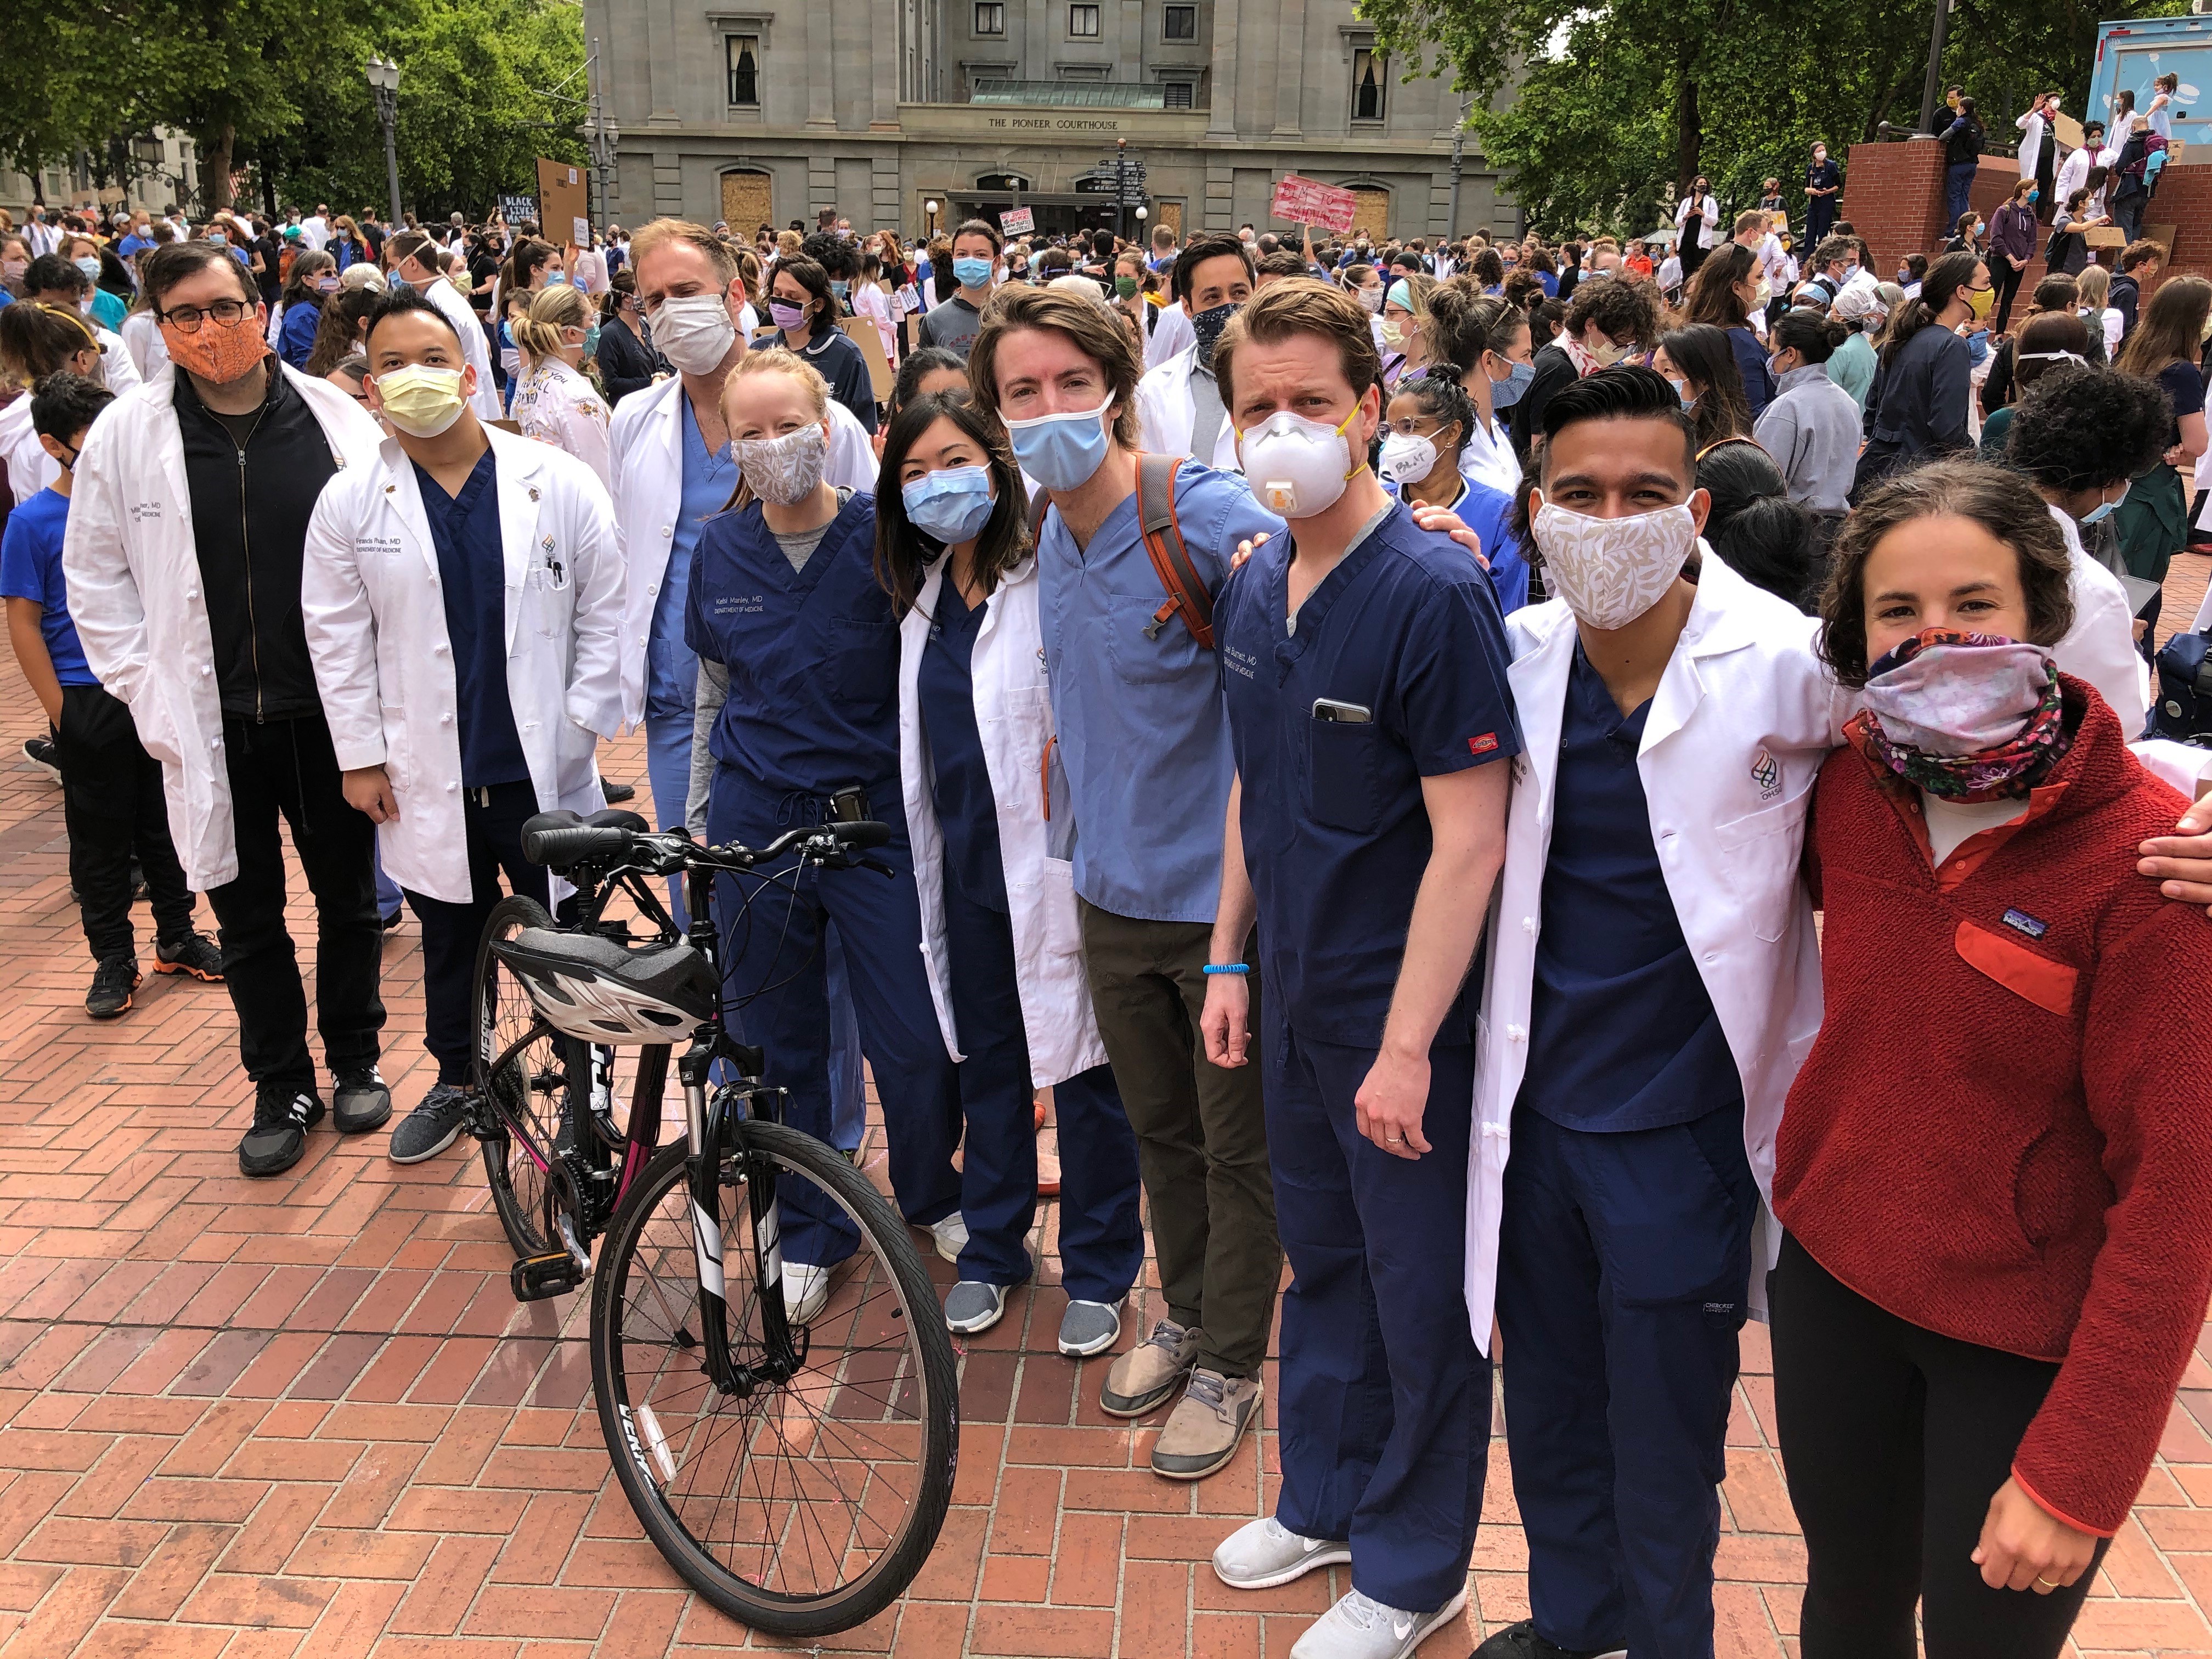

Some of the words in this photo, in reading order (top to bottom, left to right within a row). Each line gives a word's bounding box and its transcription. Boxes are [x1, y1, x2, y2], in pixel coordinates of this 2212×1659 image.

[989, 119, 1007, 127] THE
[1012, 119, 1051, 128] PIONEER
[1057, 120, 1118, 129] COURTHOUSE
[505, 196, 533, 207] BLACK
[1282, 183, 1308, 202] BLM
[1321, 193, 1334, 206] TO
[501, 204, 507, 213] #
[510, 206, 535, 215] LIVES
[548, 371, 568, 385] YOU
[533, 379, 550, 394] WILL
[1395, 452, 1425, 474] BLM
[1246, 654, 1257, 666] MD
[2002, 915, 2037, 937] patagonia
